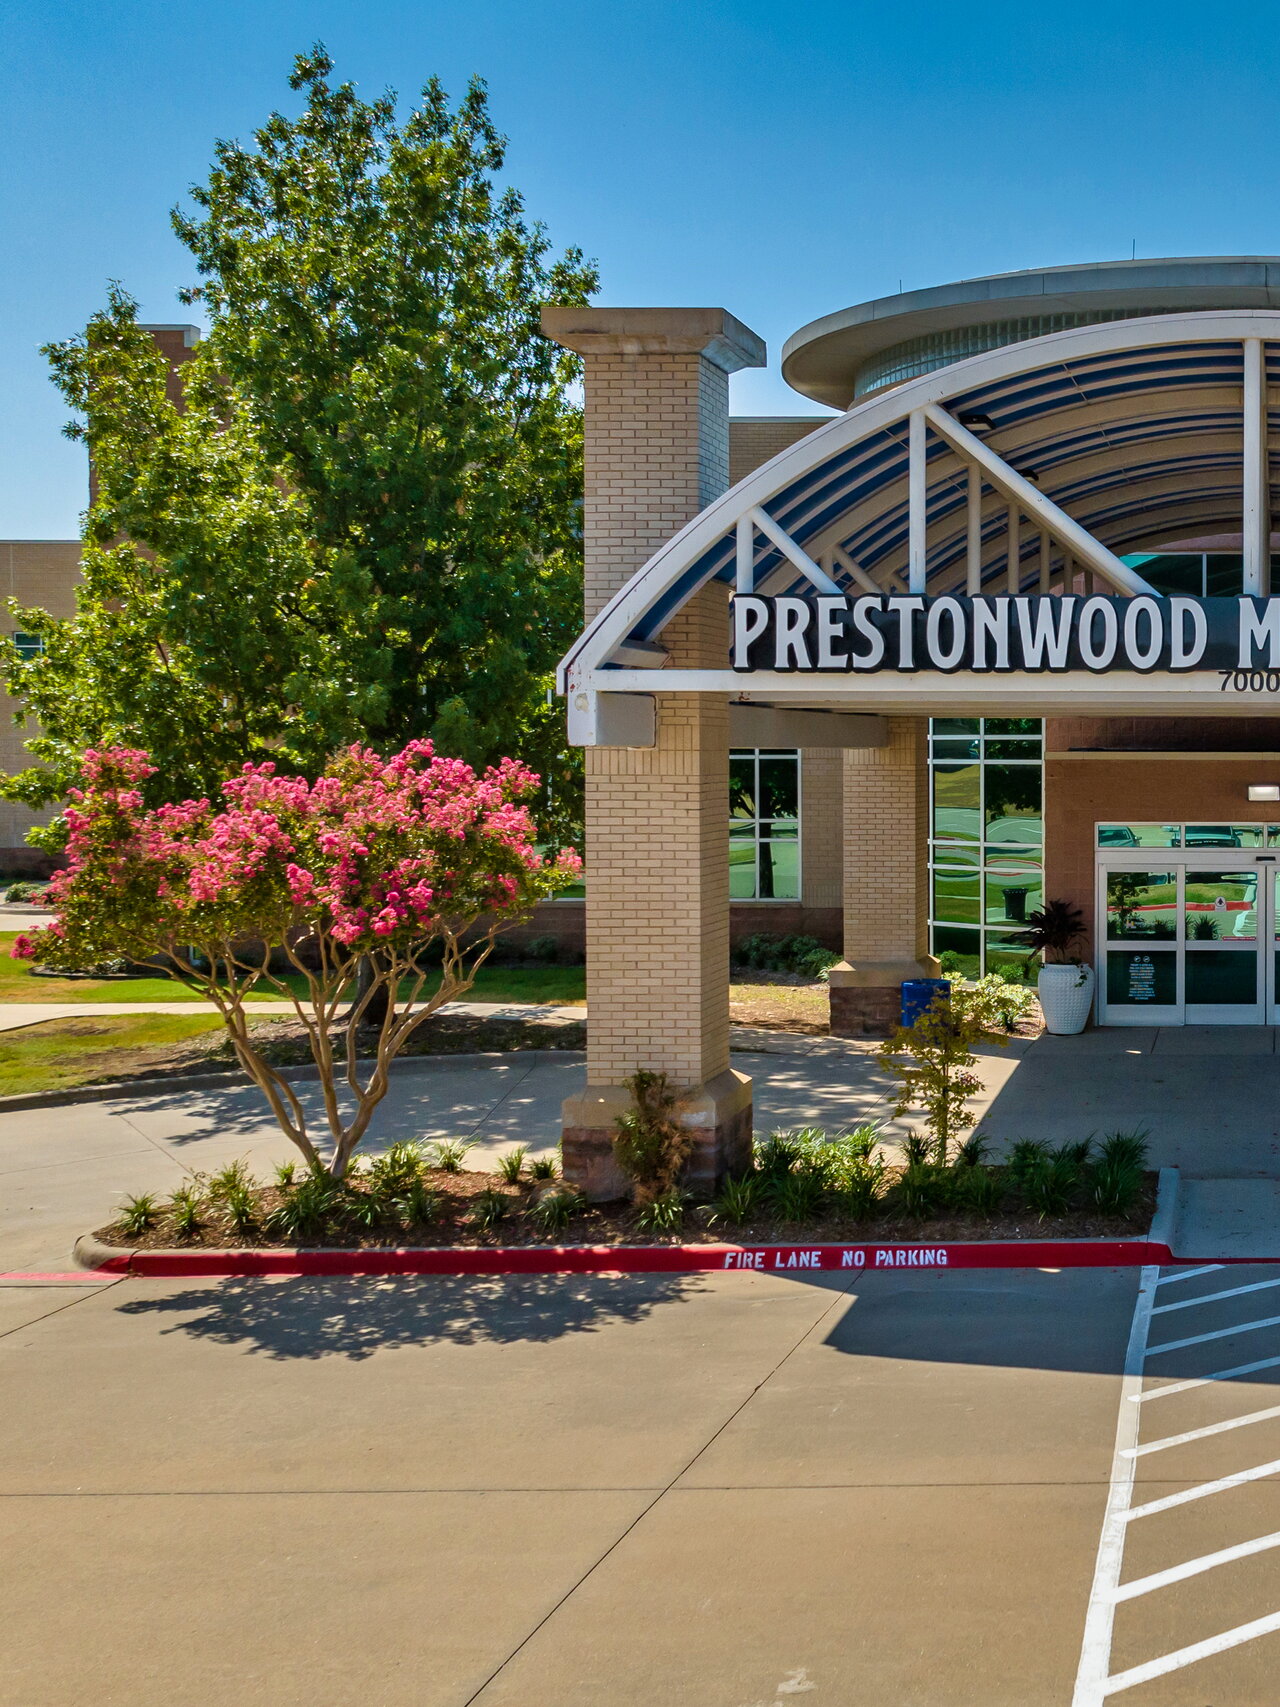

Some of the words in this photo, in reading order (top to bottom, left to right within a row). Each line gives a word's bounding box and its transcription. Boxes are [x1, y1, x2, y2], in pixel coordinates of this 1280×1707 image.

[732, 596, 1206, 668] PRESTONWOOD
[1218, 671, 1280, 692] 7000
[724, 1252, 765, 1268] FIRE
[774, 1251, 821, 1268] LANE
[841, 1250, 865, 1266] NO
[875, 1249, 948, 1266] PARKING
